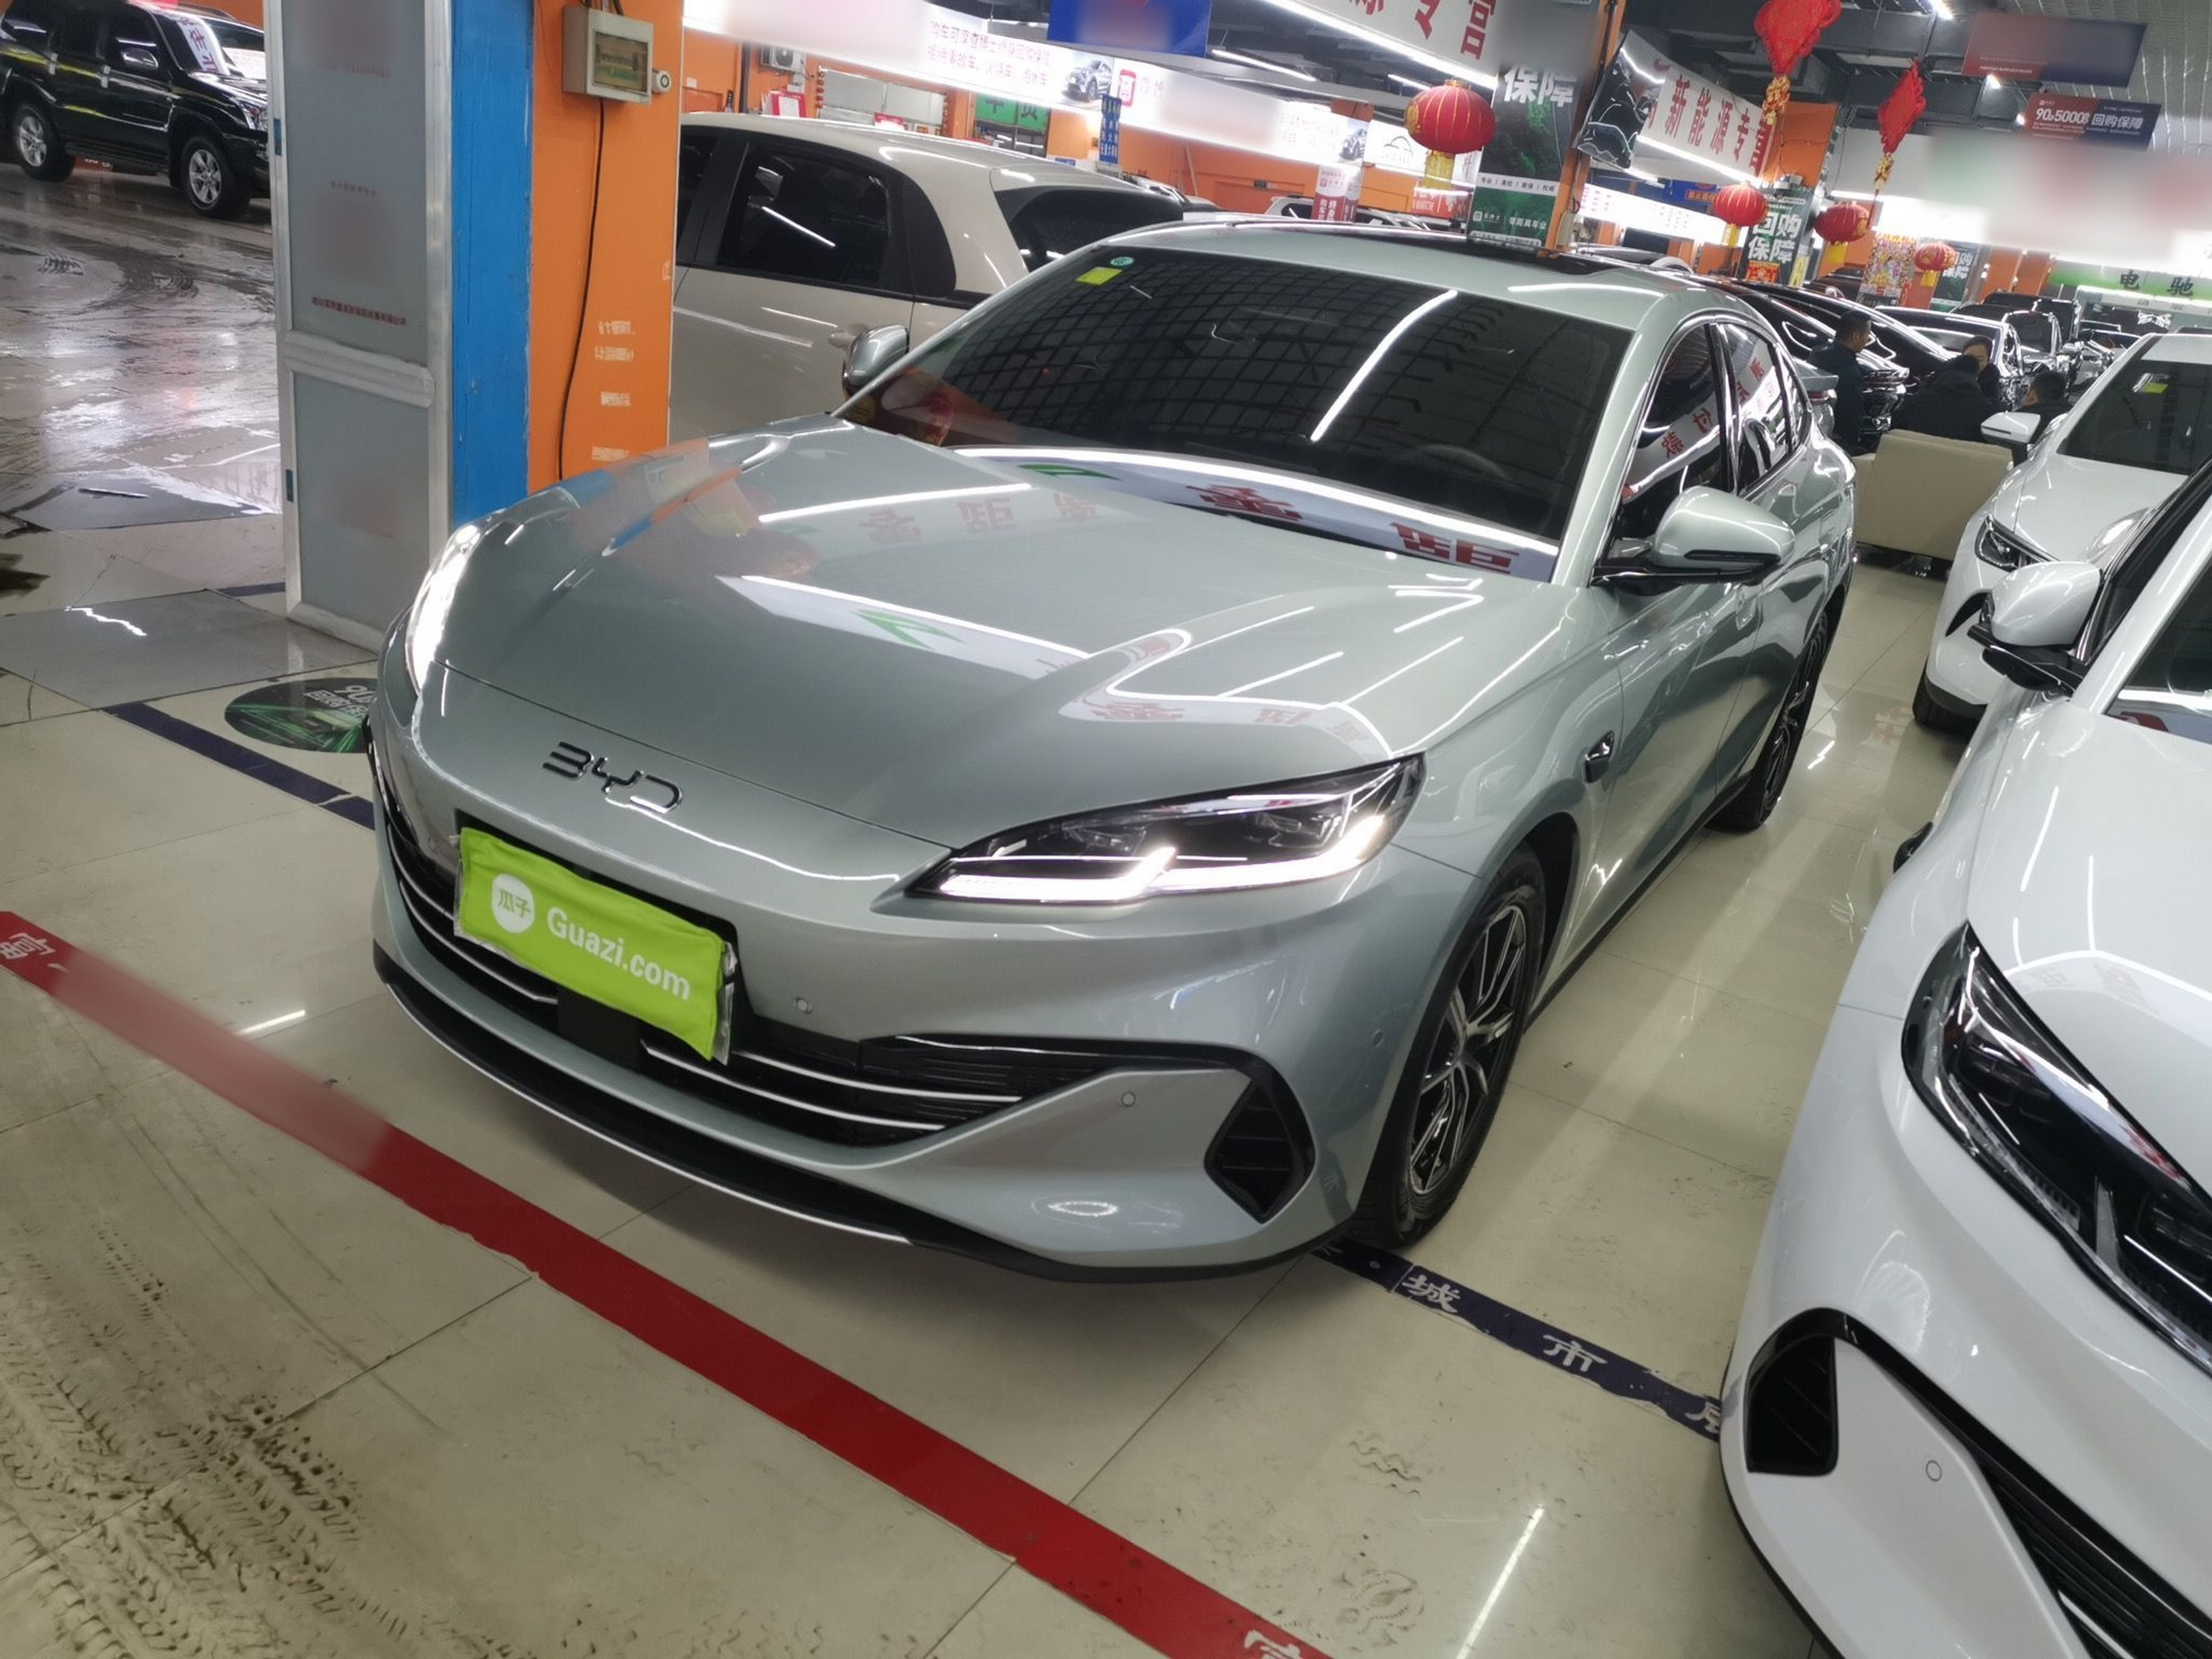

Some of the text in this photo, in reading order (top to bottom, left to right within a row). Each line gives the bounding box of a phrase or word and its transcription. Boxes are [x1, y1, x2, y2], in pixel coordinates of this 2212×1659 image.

[1503, 64, 1578, 107] 保障
[2091, 113, 2143, 130] 回购保障
[1752, 211, 1802, 238] 回购
[1747, 236, 1796, 264] 保障
[542, 741, 683, 814] BYD
[498, 889, 531, 918] 瓜子
[547, 906, 690, 1002] Guazi.com
